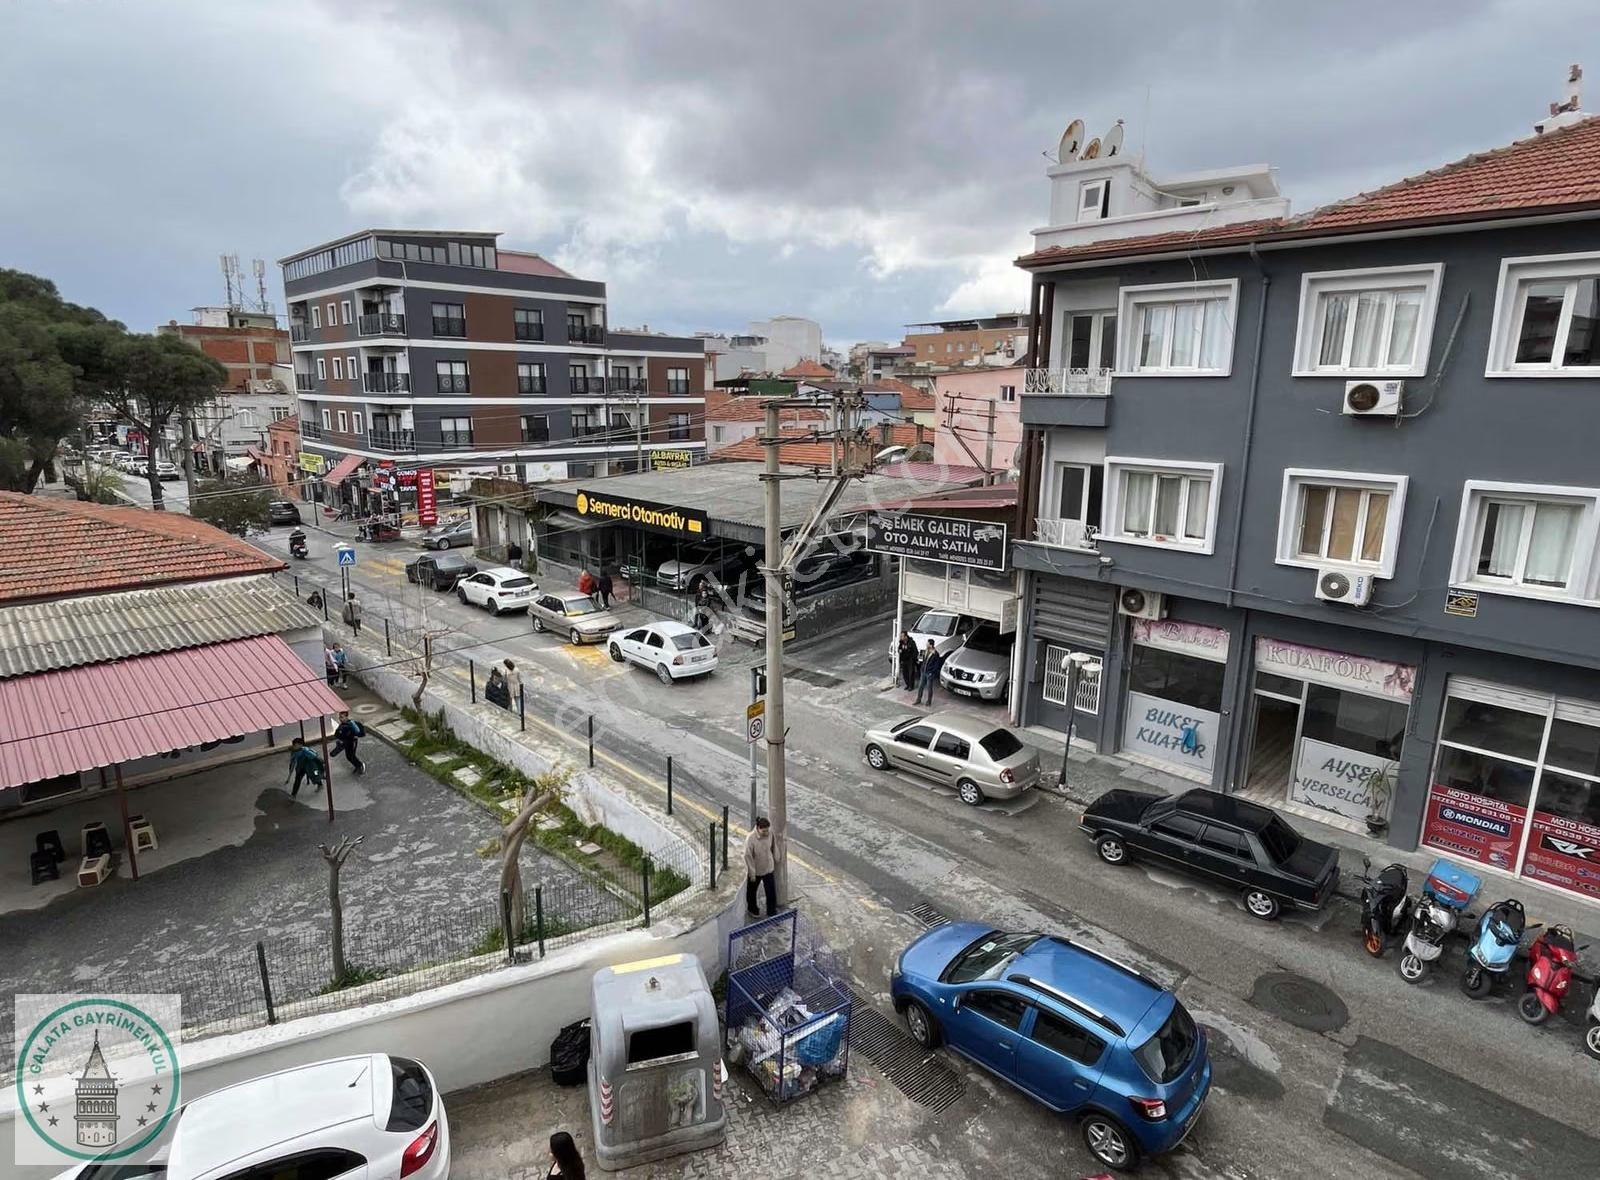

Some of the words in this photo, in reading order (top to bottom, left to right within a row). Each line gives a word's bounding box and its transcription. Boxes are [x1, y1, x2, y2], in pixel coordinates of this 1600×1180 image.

[651, 450, 690, 461] ALBAYRAK
[590, 497, 631, 520] Semerci
[632, 505, 686, 531] Otomotiv
[894, 516, 925, 532] EMEK
[928, 520, 971, 538] GALERİ
[884, 531, 909, 544] OTO
[910, 536, 939, 549] ALIM
[942, 540, 979, 555] SATIM
[1266, 645, 1372, 683] KUAFÖR
[1145, 707, 1204, 731] BUKET
[1447, 789, 1470, 801] MOTO
[1471, 795, 1510, 812] HOSPITAL
[1455, 813, 1506, 833] MONDIAL
[1551, 817, 1577, 829] MOTO
